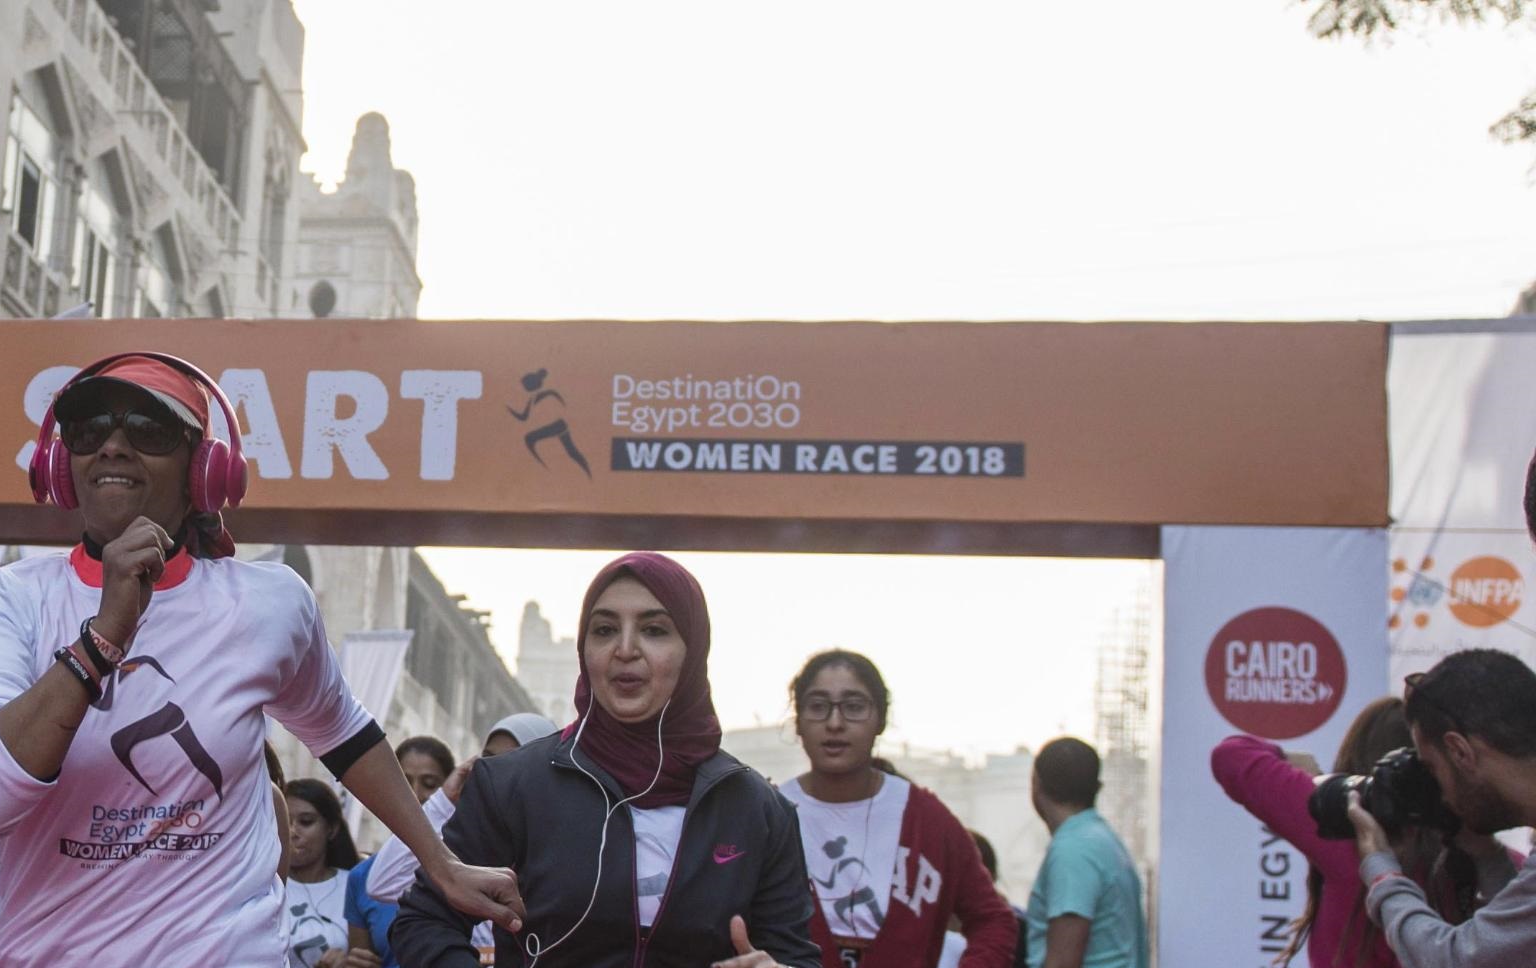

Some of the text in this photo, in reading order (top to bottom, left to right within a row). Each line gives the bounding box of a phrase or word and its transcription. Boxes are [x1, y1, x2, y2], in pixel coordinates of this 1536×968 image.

[612, 374, 801, 400] DestinatiOn
[15, 365, 483, 481] SART
[612, 402, 800, 433] Egypt 2030
[626, 442, 1005, 475] WOMEN RACE 2018
[1225, 640, 1317, 679] CAIRO
[1225, 678, 1316, 704] RUNNERS
[89, 821, 147, 843] Egypt
[66, 840, 133, 860] WOMEN
[1260, 825, 1291, 901] EGY
[892, 846, 943, 918] AP
[1260, 915, 1290, 953] IN
